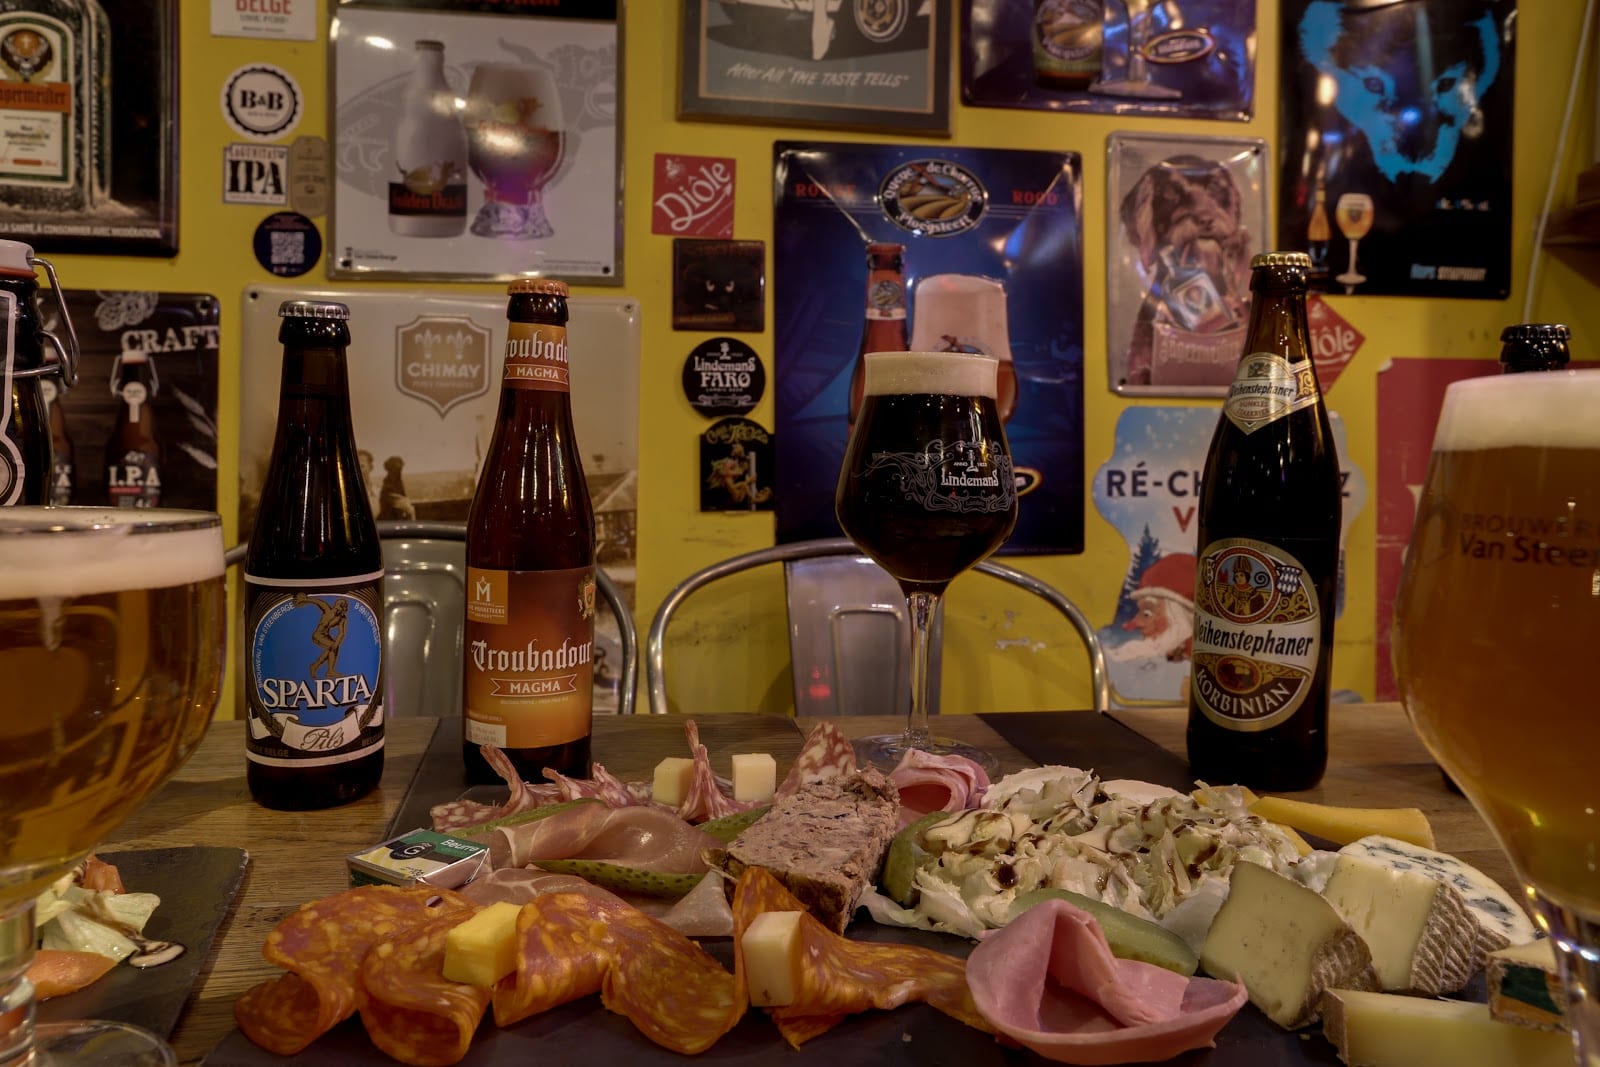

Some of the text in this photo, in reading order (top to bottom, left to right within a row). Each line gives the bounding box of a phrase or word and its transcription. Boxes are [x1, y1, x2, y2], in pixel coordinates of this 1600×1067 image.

[726, 63, 761, 79] After
[822, 72, 860, 87] TASTE
[240, 90, 283, 111] B&B
[228, 160, 283, 194] IPA
[927, 162, 942, 173] de
[655, 162, 730, 231] Diôle
[121, 325, 219, 353] CRAFT
[506, 330, 568, 364] roubad
[1311, 326, 1356, 357] iôle
[407, 362, 481, 378] CHIMAY
[517, 367, 559, 380] MAGMA
[701, 372, 751, 388] FARO
[1460, 531, 1504, 559] Van
[471, 637, 592, 673] Troubadour
[262, 674, 373, 709] SPARTA
[510, 680, 561, 694] MAGMA
[1197, 668, 1291, 715] KORBINIAN
[300, 727, 345, 750] Pils
[440, 839, 480, 852] Beurre
